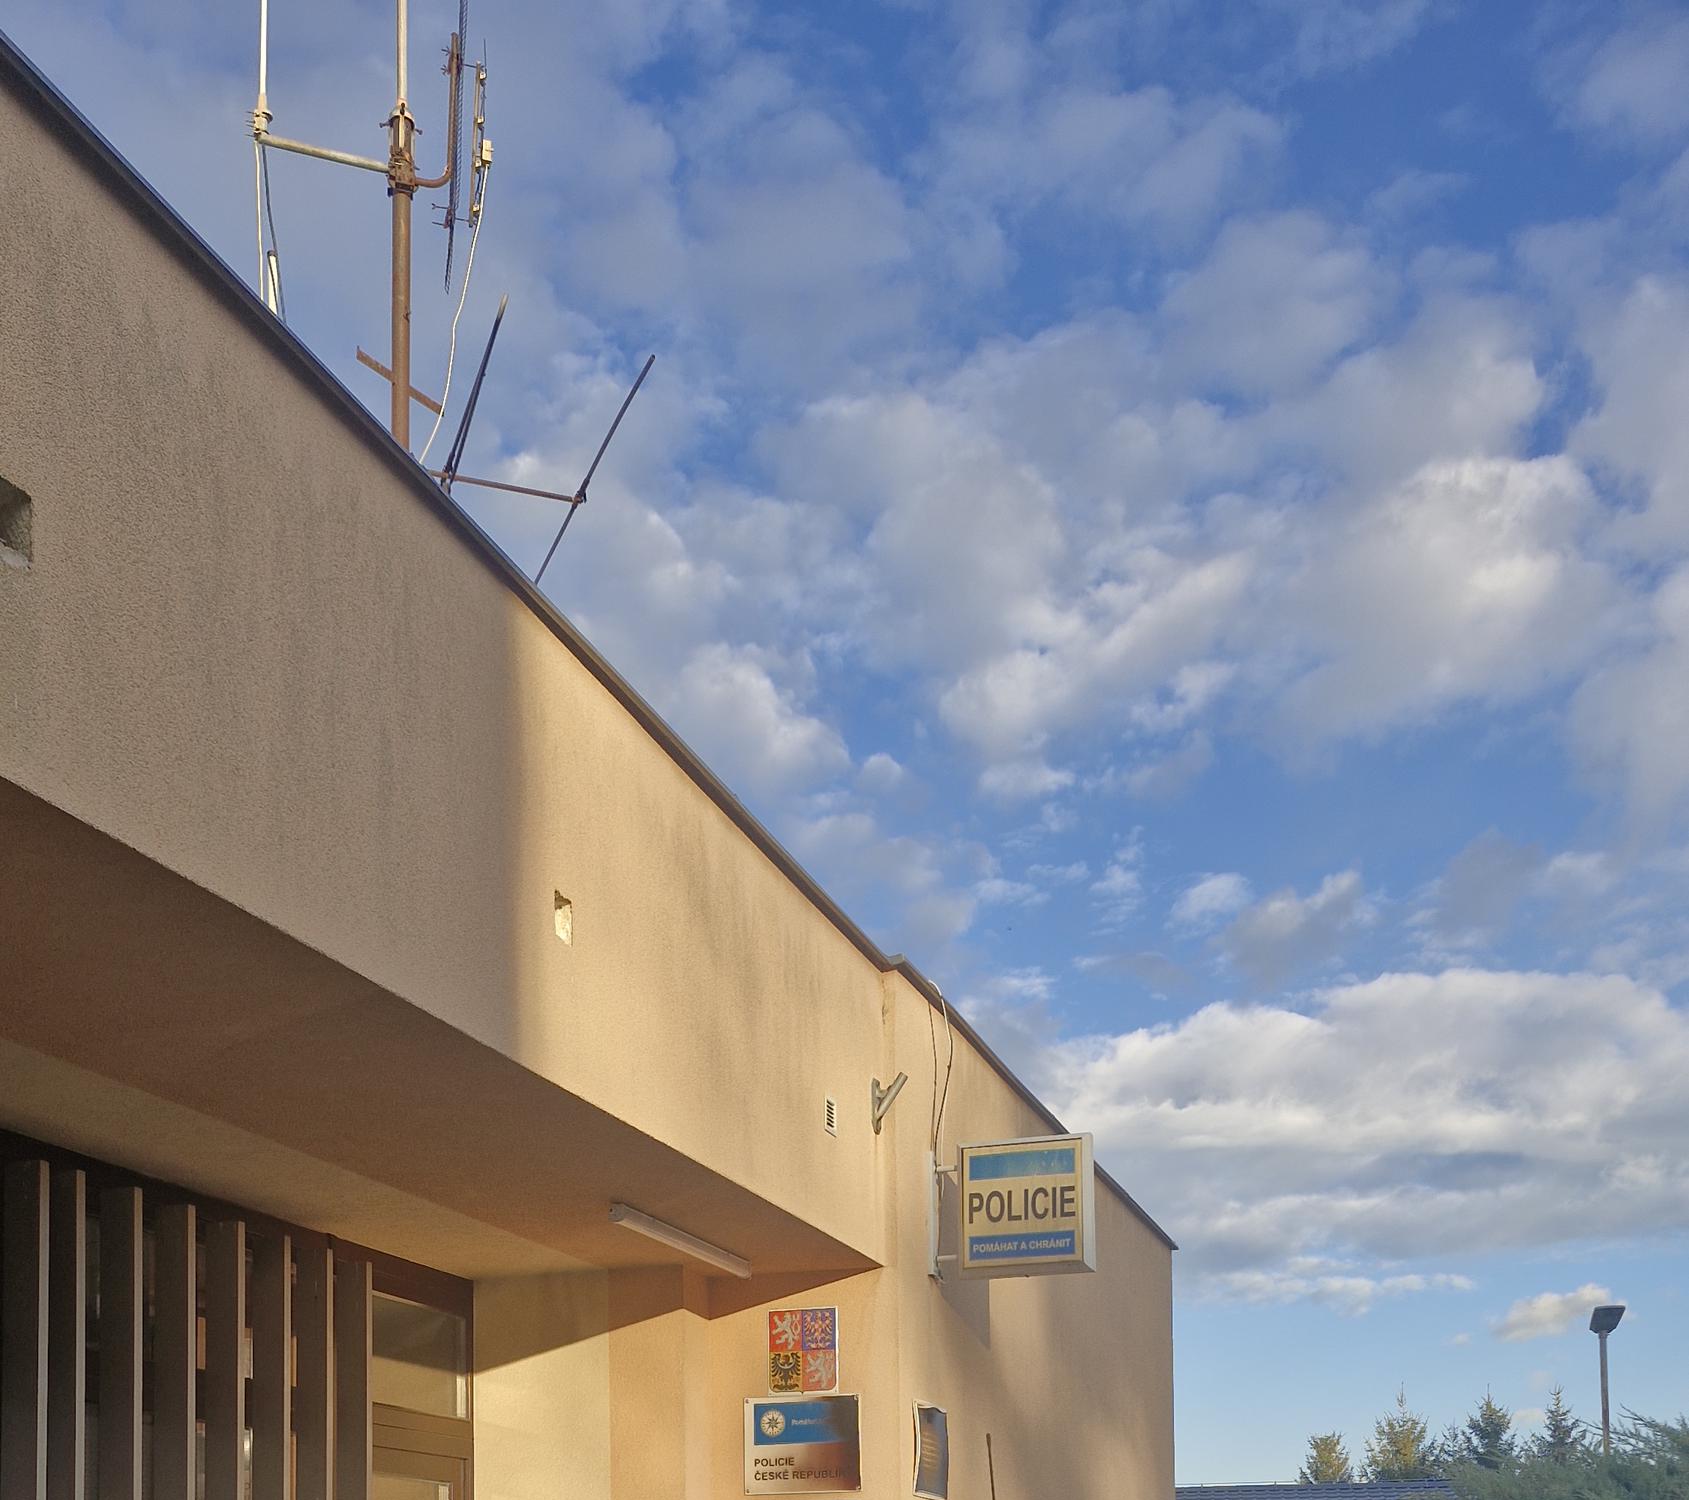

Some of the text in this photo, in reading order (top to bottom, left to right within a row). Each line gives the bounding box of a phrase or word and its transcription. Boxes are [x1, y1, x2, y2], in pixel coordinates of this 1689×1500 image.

[969, 1186, 1076, 1224] POLICIE
[972, 1238, 1072, 1254] POMÁHAT A CHRÁNIT
[754, 1457, 795, 1468] POLICIE
[754, 1468, 789, 1481] ČESKÉ
